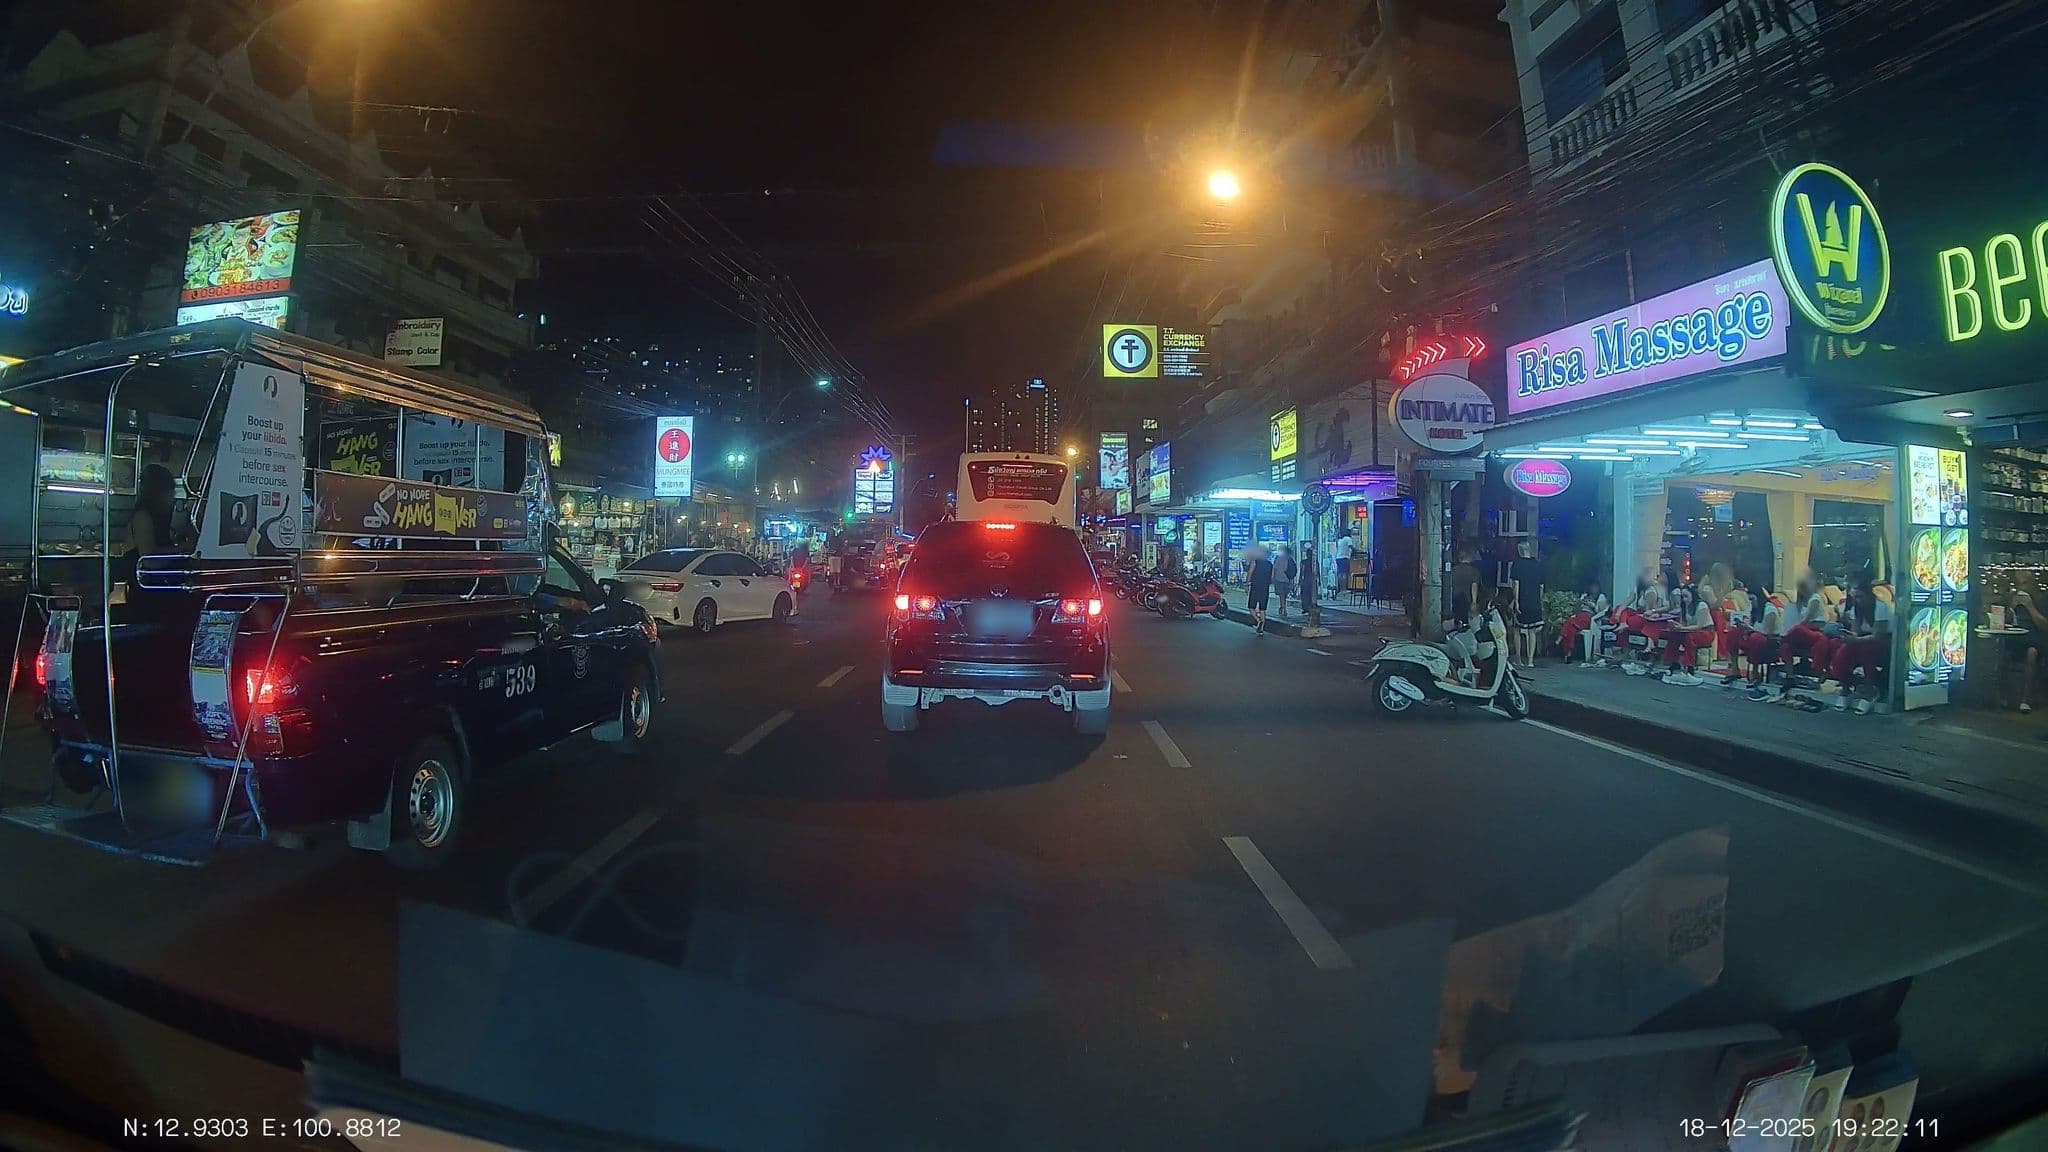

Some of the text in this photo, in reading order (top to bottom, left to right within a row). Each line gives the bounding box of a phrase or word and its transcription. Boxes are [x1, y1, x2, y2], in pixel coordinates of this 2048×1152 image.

[200, 279, 280, 297] 0903184613
[387, 346, 440, 356] Stamp Color
[1518, 344, 1587, 397] Risa
[1593, 291, 1773, 378] Massage
[1401, 399, 1495, 423] INTIMATE
[247, 415, 284, 432] Boost up
[242, 429, 287, 446] your libido.
[1430, 428, 1467, 439] HOTEL
[264, 447, 272, 457] 15
[419, 442, 439, 450] Boost
[440, 442, 449, 450] up
[450, 441, 467, 450] your
[242, 458, 286, 473] before sex
[414, 457, 436, 466] before
[1943, 455, 1955, 464] BUY
[239, 472, 288, 488] intercourse.
[1516, 469, 1568, 487] Risa Massage
[396, 489, 431, 500] NO MORE
[506, 665, 536, 698] 539
